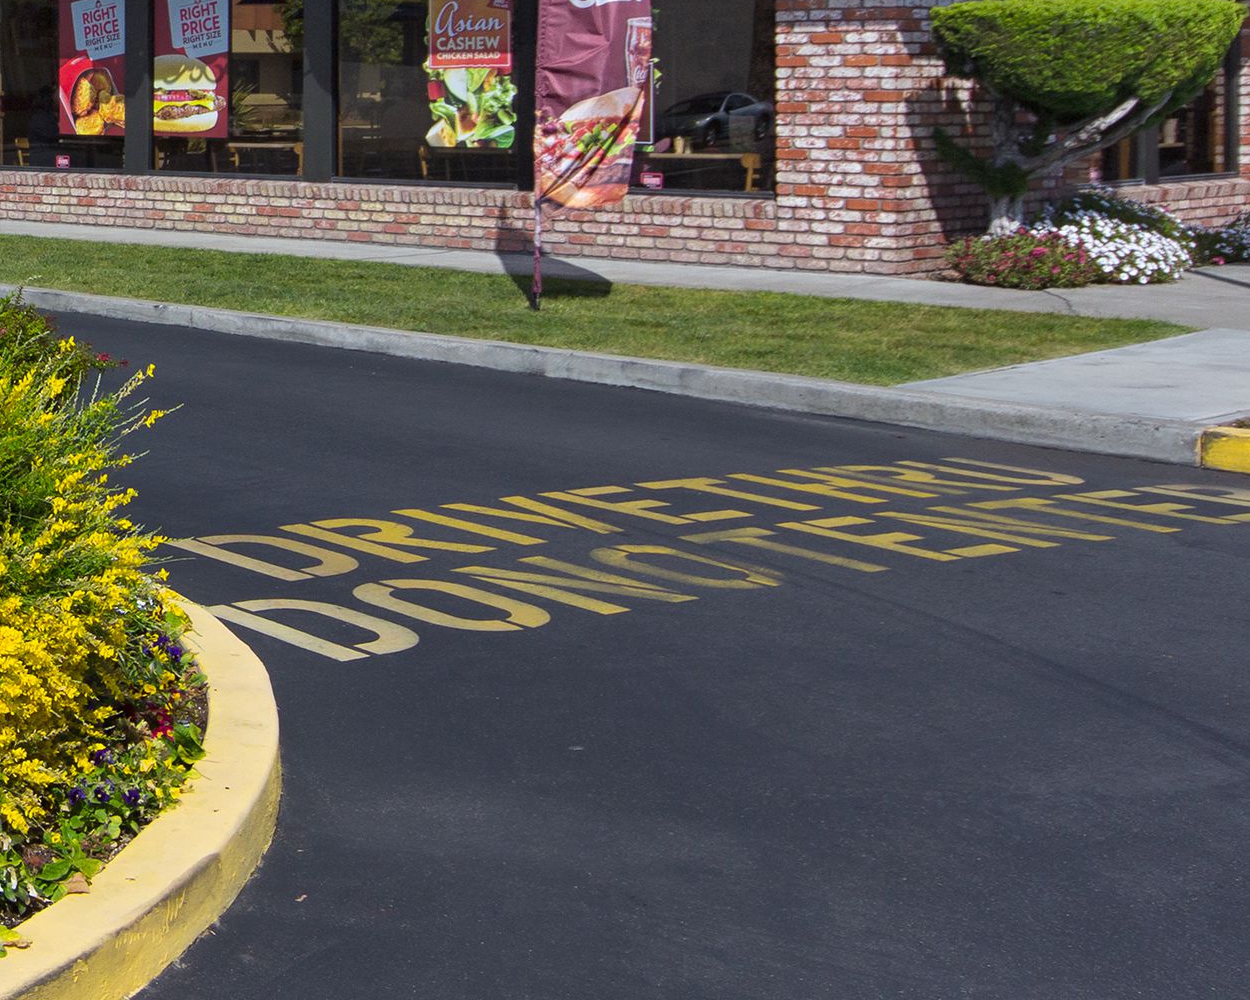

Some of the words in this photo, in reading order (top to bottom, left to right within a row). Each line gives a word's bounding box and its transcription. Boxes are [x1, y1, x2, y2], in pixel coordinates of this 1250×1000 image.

[82, 5, 118, 25] RIGHT
[180, 1, 218, 22] RIGHT
[435, 0, 505, 37] Asian
[83, 19, 119, 39] PRICE
[181, 15, 221, 37] PRICE
[85, 36, 105, 47] RIGHT
[106, 33, 120, 42] SIZE
[183, 33, 205, 45] RIGHT
[206, 30, 222, 40] SIZE
[436, 36, 500, 51] CASHEW
[94, 43, 113, 51] MENU
[193, 41, 214, 50] MENU
[437, 52, 473, 60] CHICKEN
[474, 51, 501, 59] SALAD
